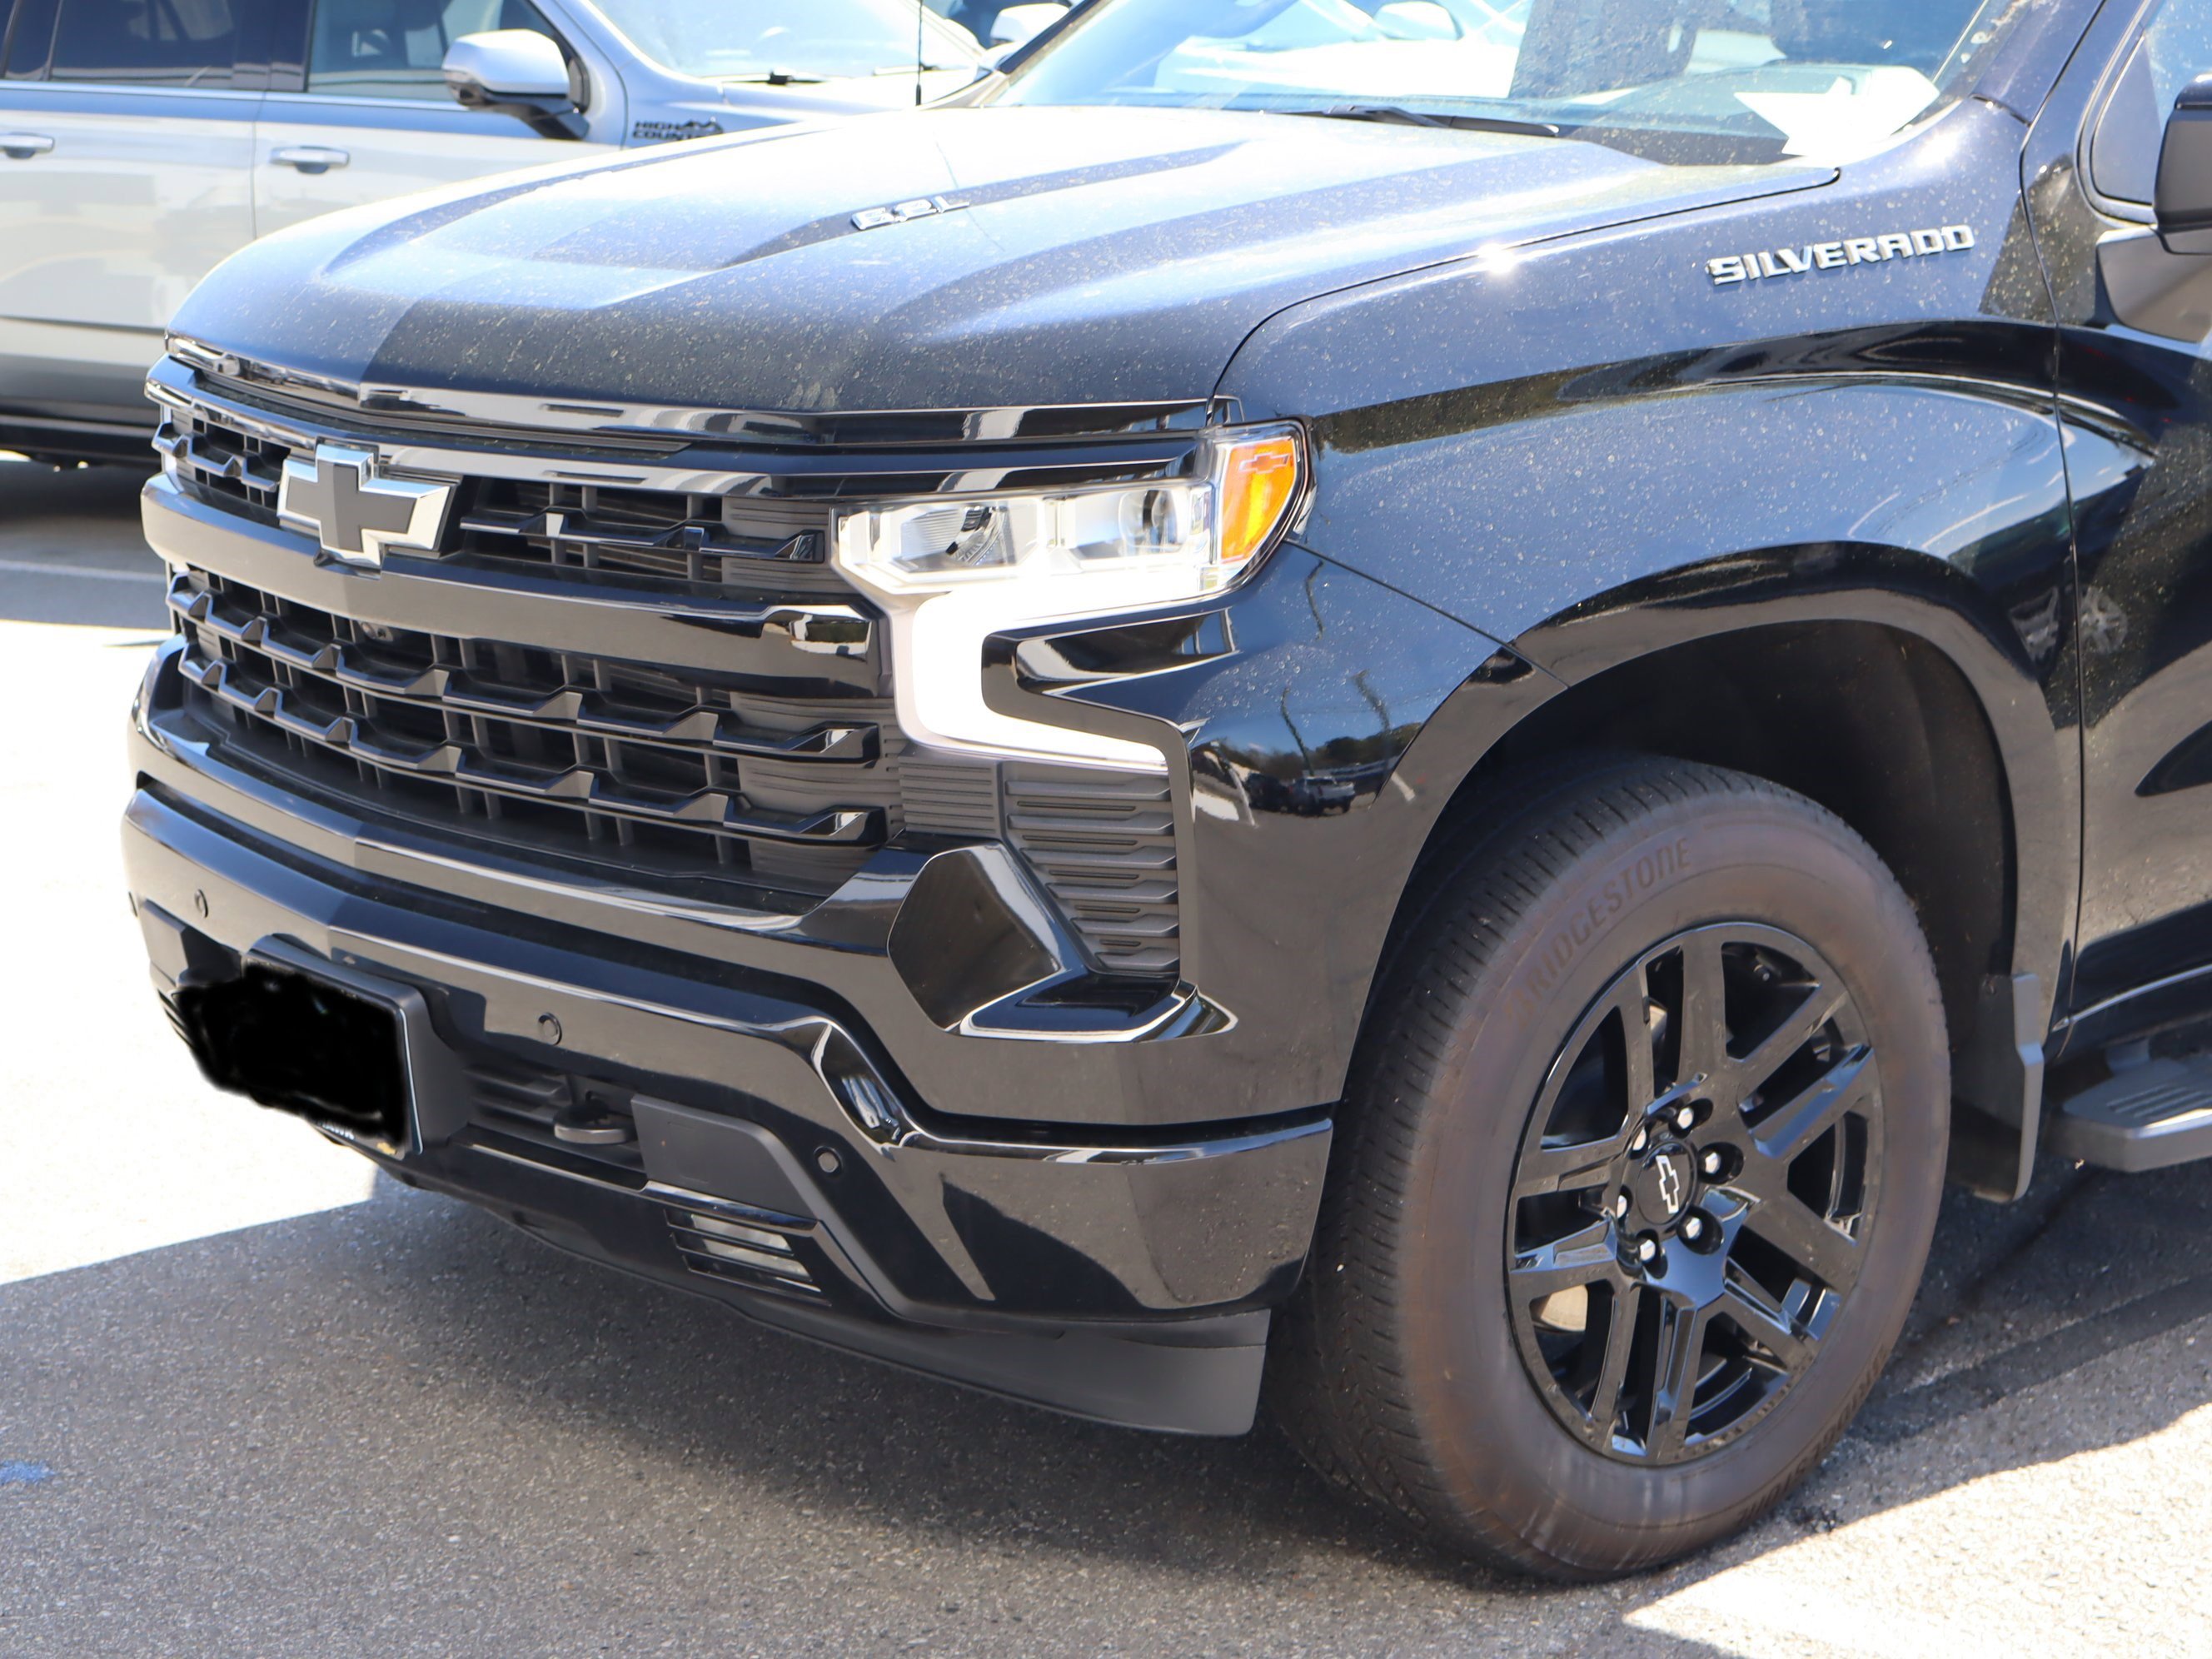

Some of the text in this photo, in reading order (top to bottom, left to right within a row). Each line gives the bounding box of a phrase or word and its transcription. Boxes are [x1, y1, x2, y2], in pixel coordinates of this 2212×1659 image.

[635, 120, 683, 130] HIGH
[851, 195, 970, 231] 6.2L
[1706, 225, 1975, 286] SILVERADO
